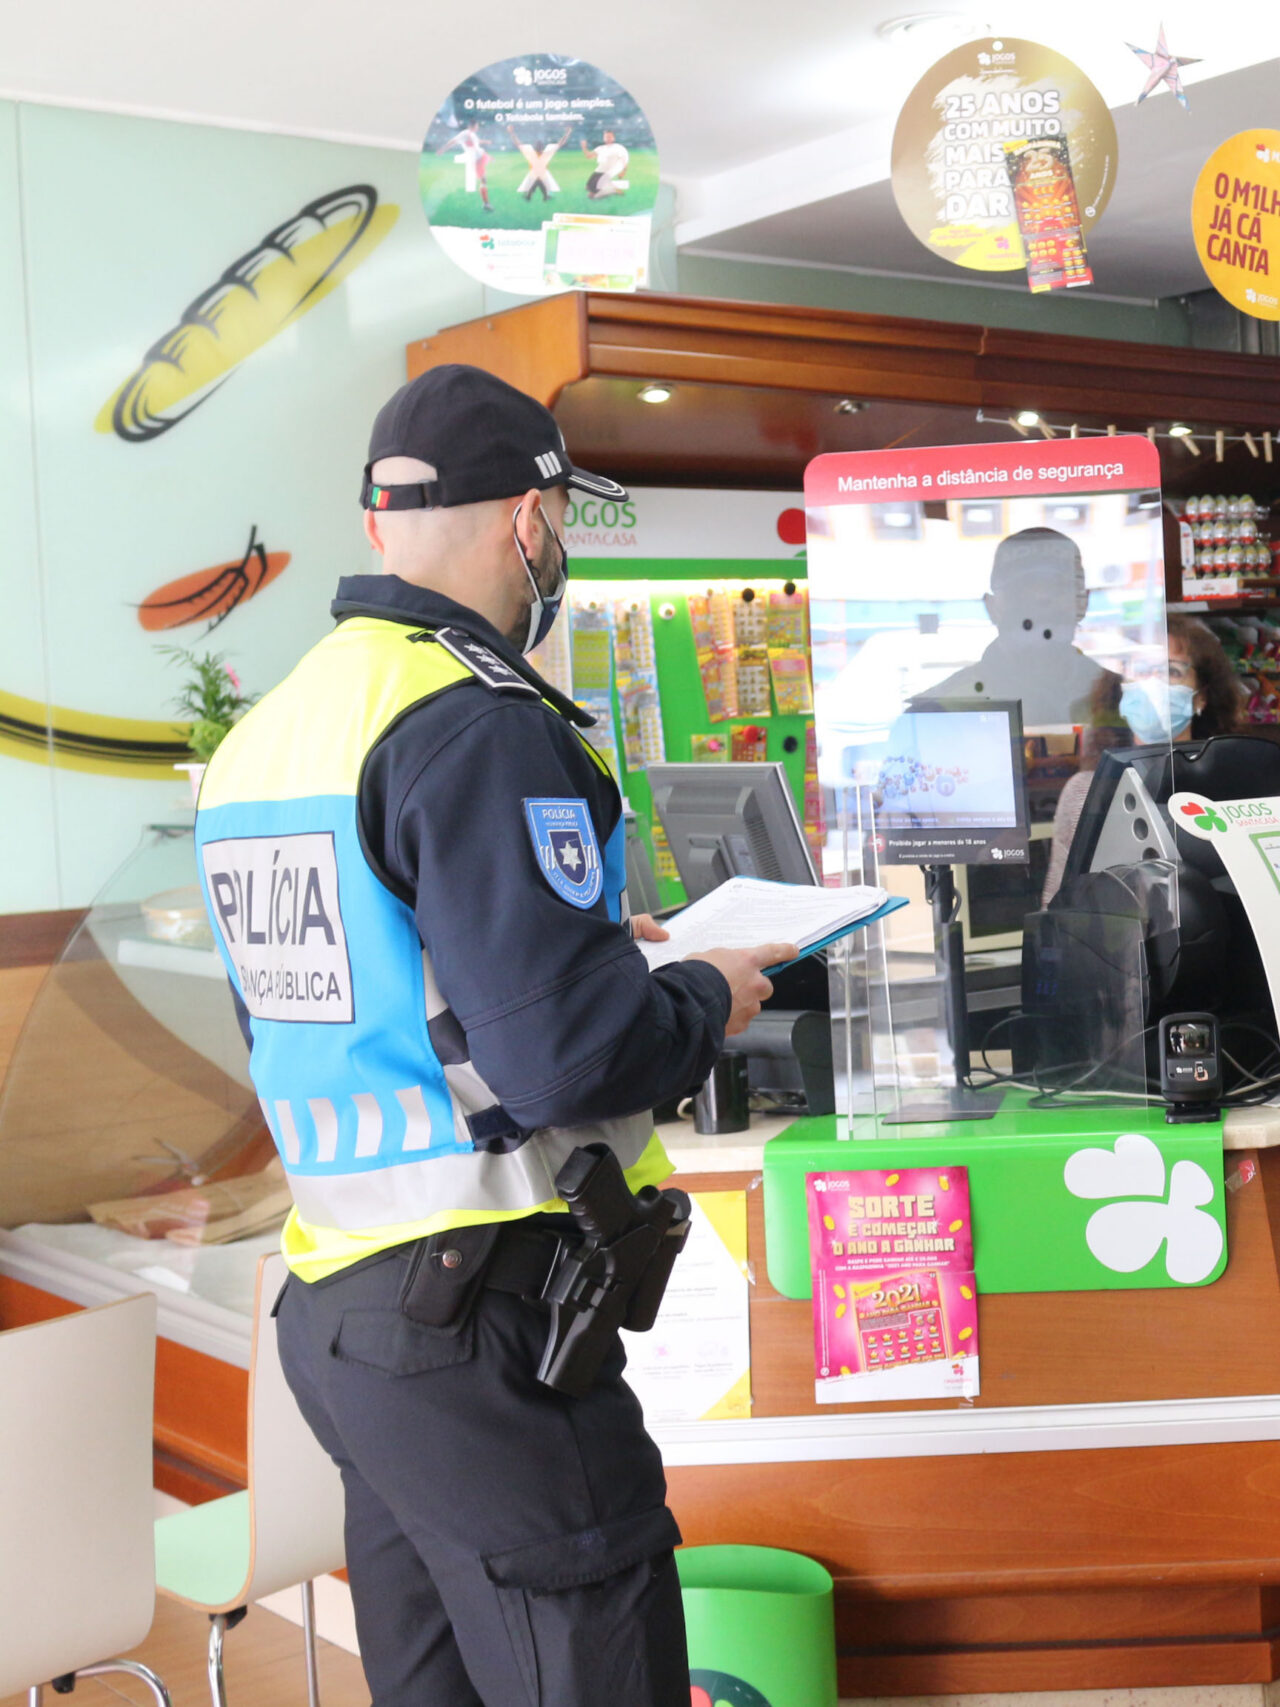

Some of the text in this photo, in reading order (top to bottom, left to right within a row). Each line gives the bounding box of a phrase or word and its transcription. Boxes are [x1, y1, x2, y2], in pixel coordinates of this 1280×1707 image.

[533, 69, 567, 83] JOGOS
[464, 99, 474, 109] O
[476, 98, 514, 110] futebol
[525, 101, 543, 109] um
[544, 99, 568, 111] jogo
[945, 90, 1060, 119] 25 ANOS
[495, 113, 503, 122] O
[943, 117, 1061, 141] COM MUITO
[944, 143, 1006, 166] MAIS
[1023, 149, 1054, 172] 25
[944, 166, 1012, 190] PARA
[1214, 172, 1229, 199] O
[945, 191, 1011, 219] DAR
[1209, 203, 1262, 244] JÁ CÁ
[1206, 234, 1269, 276] CANTA
[837, 462, 1124, 493] Mantenha a distância de segurança
[563, 500, 637, 529] OGOS
[564, 532, 638, 547] ANTACASA
[541, 806, 576, 819] POLÍCIA
[1220, 802, 1273, 824] JOGOS
[1003, 849, 1025, 859] JOGOS
[847, 1195, 936, 1219] SORTE
[862, 1221, 938, 1240] COMEÇAR
[832, 1238, 955, 1256] O ANO A GANHAR
[872, 1283, 921, 1309] 2021
